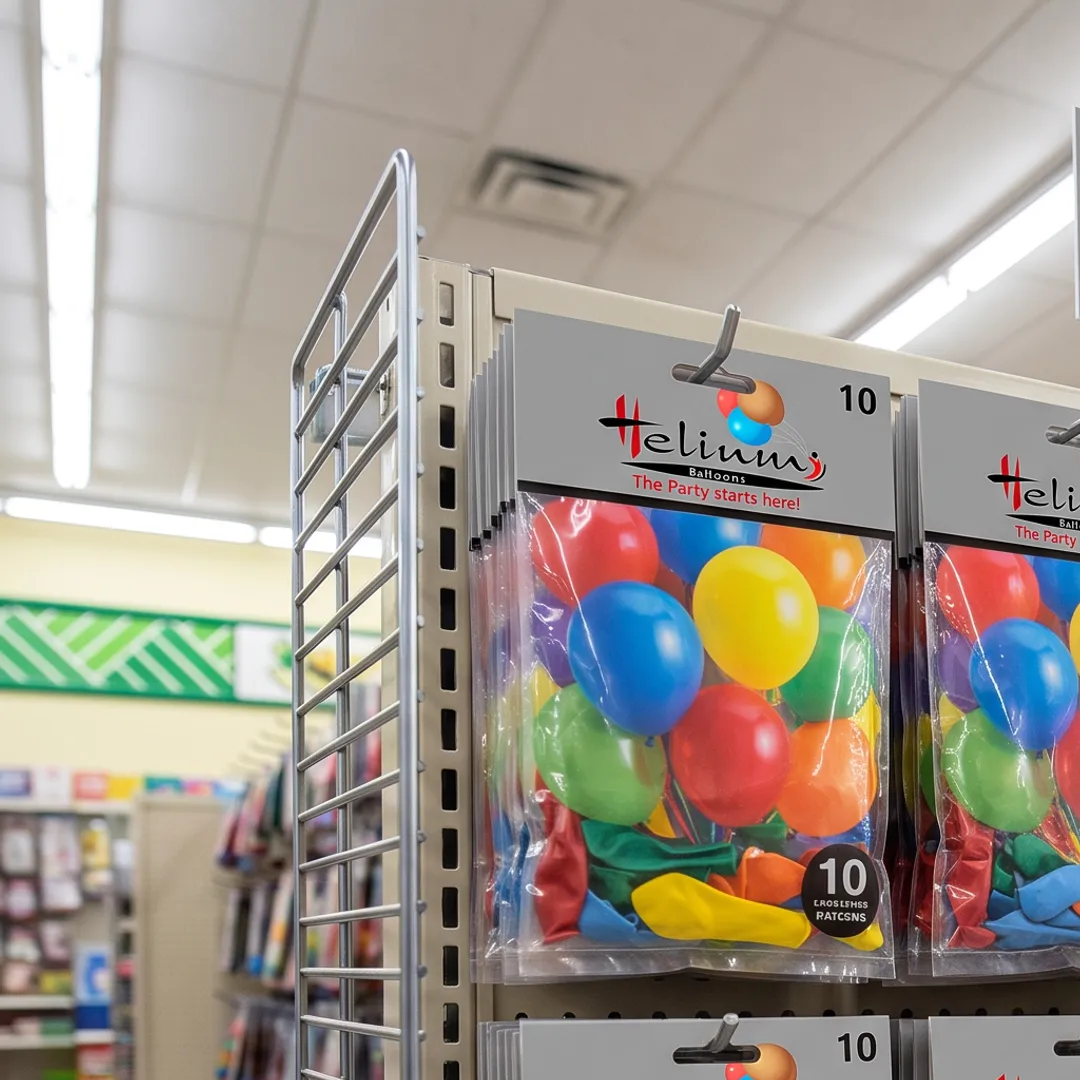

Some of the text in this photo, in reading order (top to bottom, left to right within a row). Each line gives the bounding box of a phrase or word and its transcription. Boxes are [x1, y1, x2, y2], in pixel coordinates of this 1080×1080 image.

[840, 384, 877, 415] 10
[598, 394, 808, 472] Helium
[632, 474, 800, 510] The Party starts here!
[1015, 525, 1039, 540] The
[1043, 531, 1077, 548] Party
[819, 857, 867, 896] 10
[838, 1032, 877, 1063] 10
